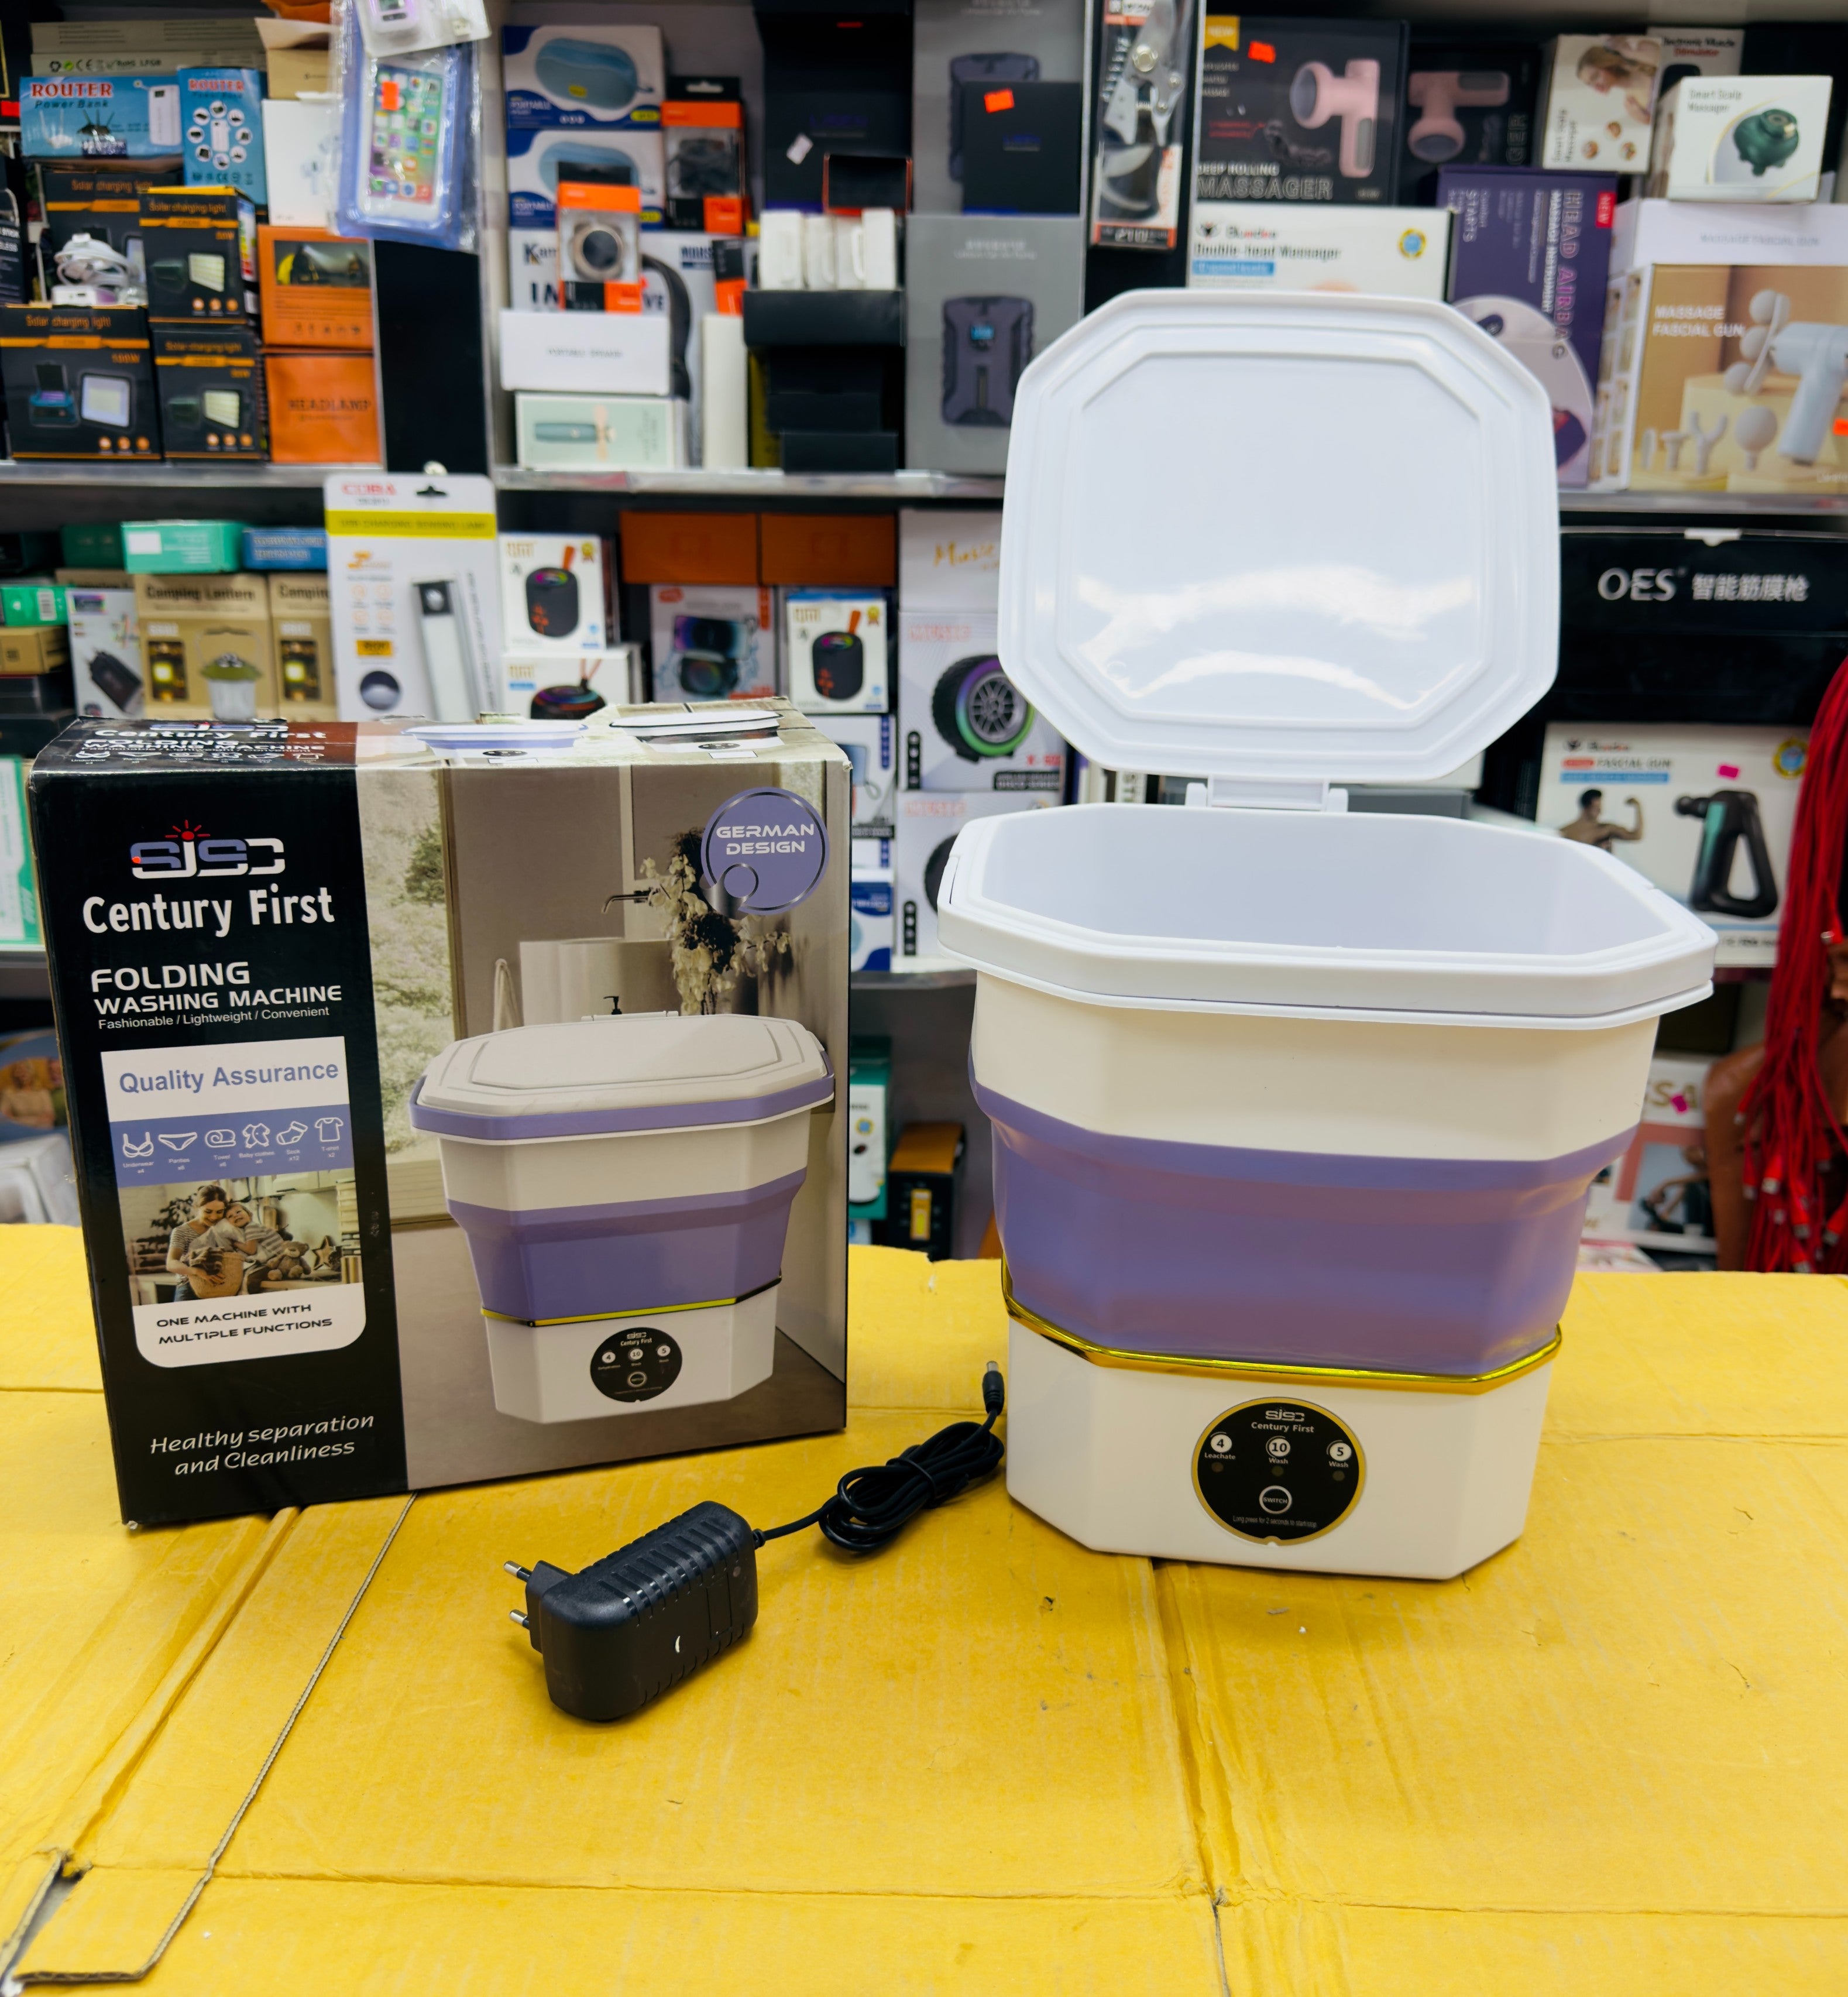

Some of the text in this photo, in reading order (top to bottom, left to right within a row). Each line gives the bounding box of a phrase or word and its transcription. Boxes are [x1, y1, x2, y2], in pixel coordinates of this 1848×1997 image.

[32, 83, 113, 98] ROUTER
[188, 79, 245, 92] ROUTER
[35, 99, 109, 109] Power Bank
[1198, 177, 1333, 199] MASSAGER
[1279, 245, 1341, 260] Massager
[1552, 190, 1583, 361] HEAD AIRBAG
[1654, 304, 1725, 320] MASSAGE
[26, 315, 49, 327] Solar
[92, 315, 111, 328] light
[1652, 322, 1745, 338] FASCIAL GUN
[1598, 568, 1677, 602] OES
[1692, 573, 1810, 602] 智能筋膜枪
[146, 586, 256, 602] Camping Lantern
[95, 730, 327, 739] Century First
[716, 823, 815, 839] GERMAN
[726, 840, 806, 856] DESIGN
[82, 894, 232, 938] Century
[249, 883, 335, 926] First
[90, 961, 250, 993] FOLDING
[93, 985, 342, 1015] WASHING MACHINE
[98, 1014, 174, 1030] Fashionable
[183, 1010, 253, 1026] Lightweight
[261, 1006, 330, 1021] Convenient
[119, 1062, 339, 1094] Quality Assurance
[122, 1161, 154, 1169] Underwear
[156, 1303, 312, 1328] ONE MACHINE WITH
[158, 1318, 334, 1346] MULTIPLE FUNCTIONS
[620, 1339, 640, 1347] Century
[150, 1415, 375, 1455] Healthy separation
[1251, 1421, 1315, 1433] Century First
[1216, 1438, 1225, 1448] 4
[1271, 1442, 1288, 1453] 10
[174, 1442, 356, 1476] and Cleanliness
[1204, 1452, 1236, 1460] Leachate
[1337, 1447, 1344, 1457] 5
[1268, 1457, 1289, 1465] Wash
[1262, 1496, 1289, 1504] SWITCH
[1232, 1515, 1245, 1524] Long
